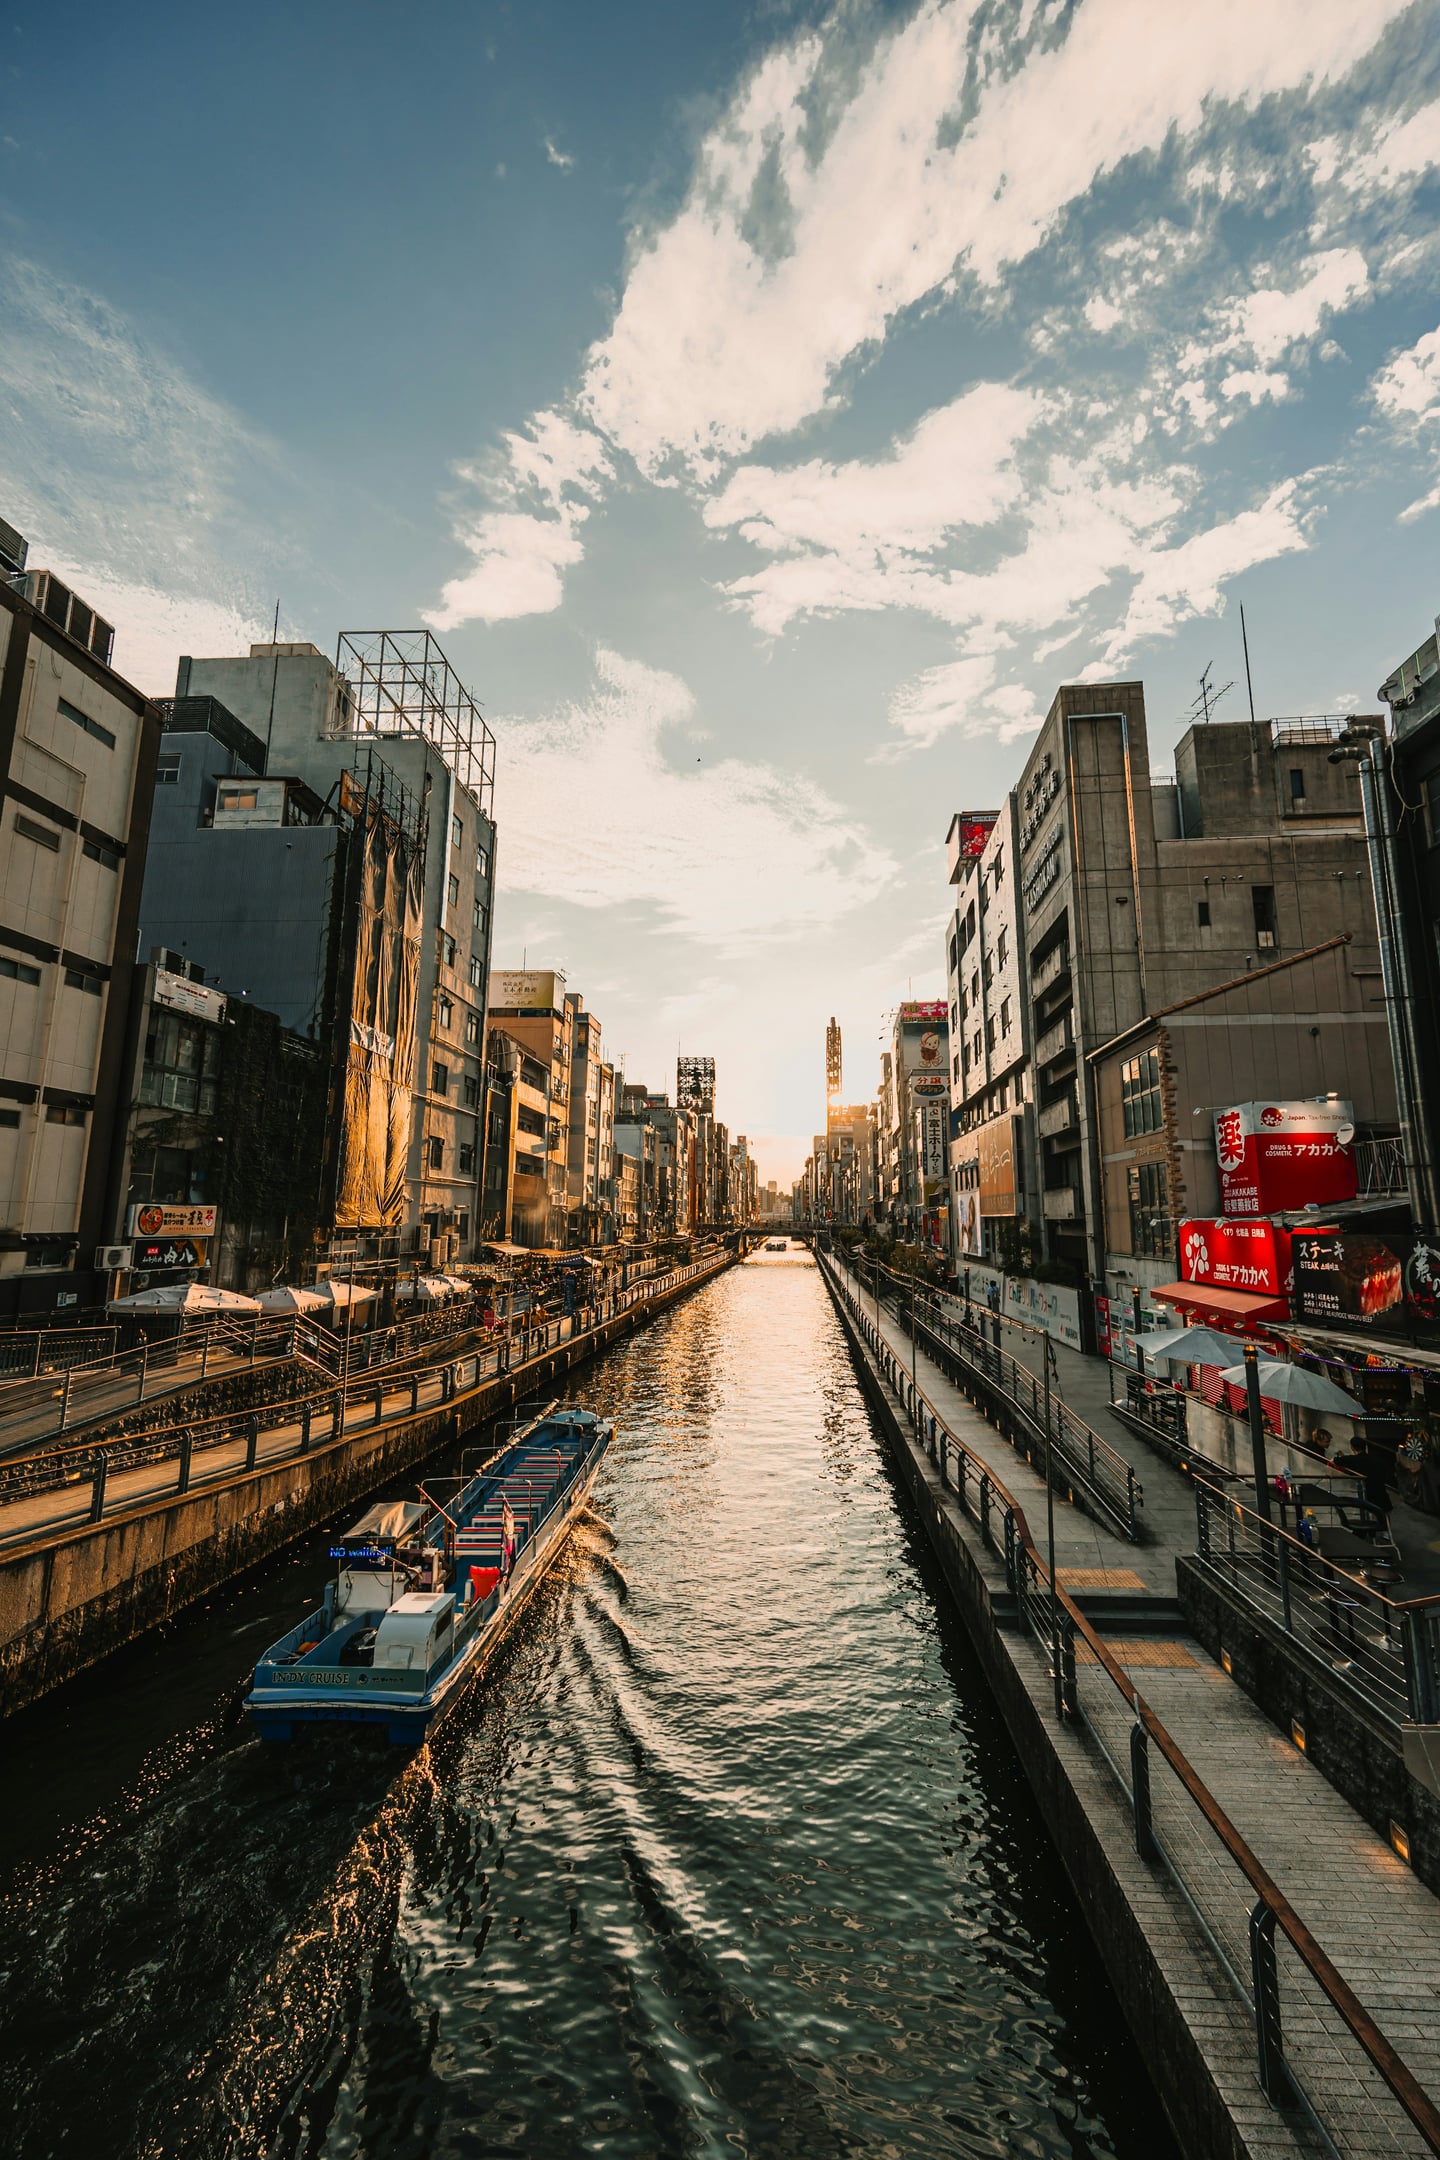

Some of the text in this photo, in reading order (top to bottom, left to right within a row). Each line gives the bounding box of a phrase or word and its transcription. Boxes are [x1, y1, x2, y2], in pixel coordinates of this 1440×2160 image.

[1232, 1187, 1258, 1196] AKAKABE
[1300, 1241, 1344, 1260] ステーキ
[1300, 1261, 1319, 1270] STEAK
[1231, 1265, 1269, 1287] アカカベ
[330, 1547, 346, 1557] NO
[272, 1671, 349, 1684] INDY CRUISE
